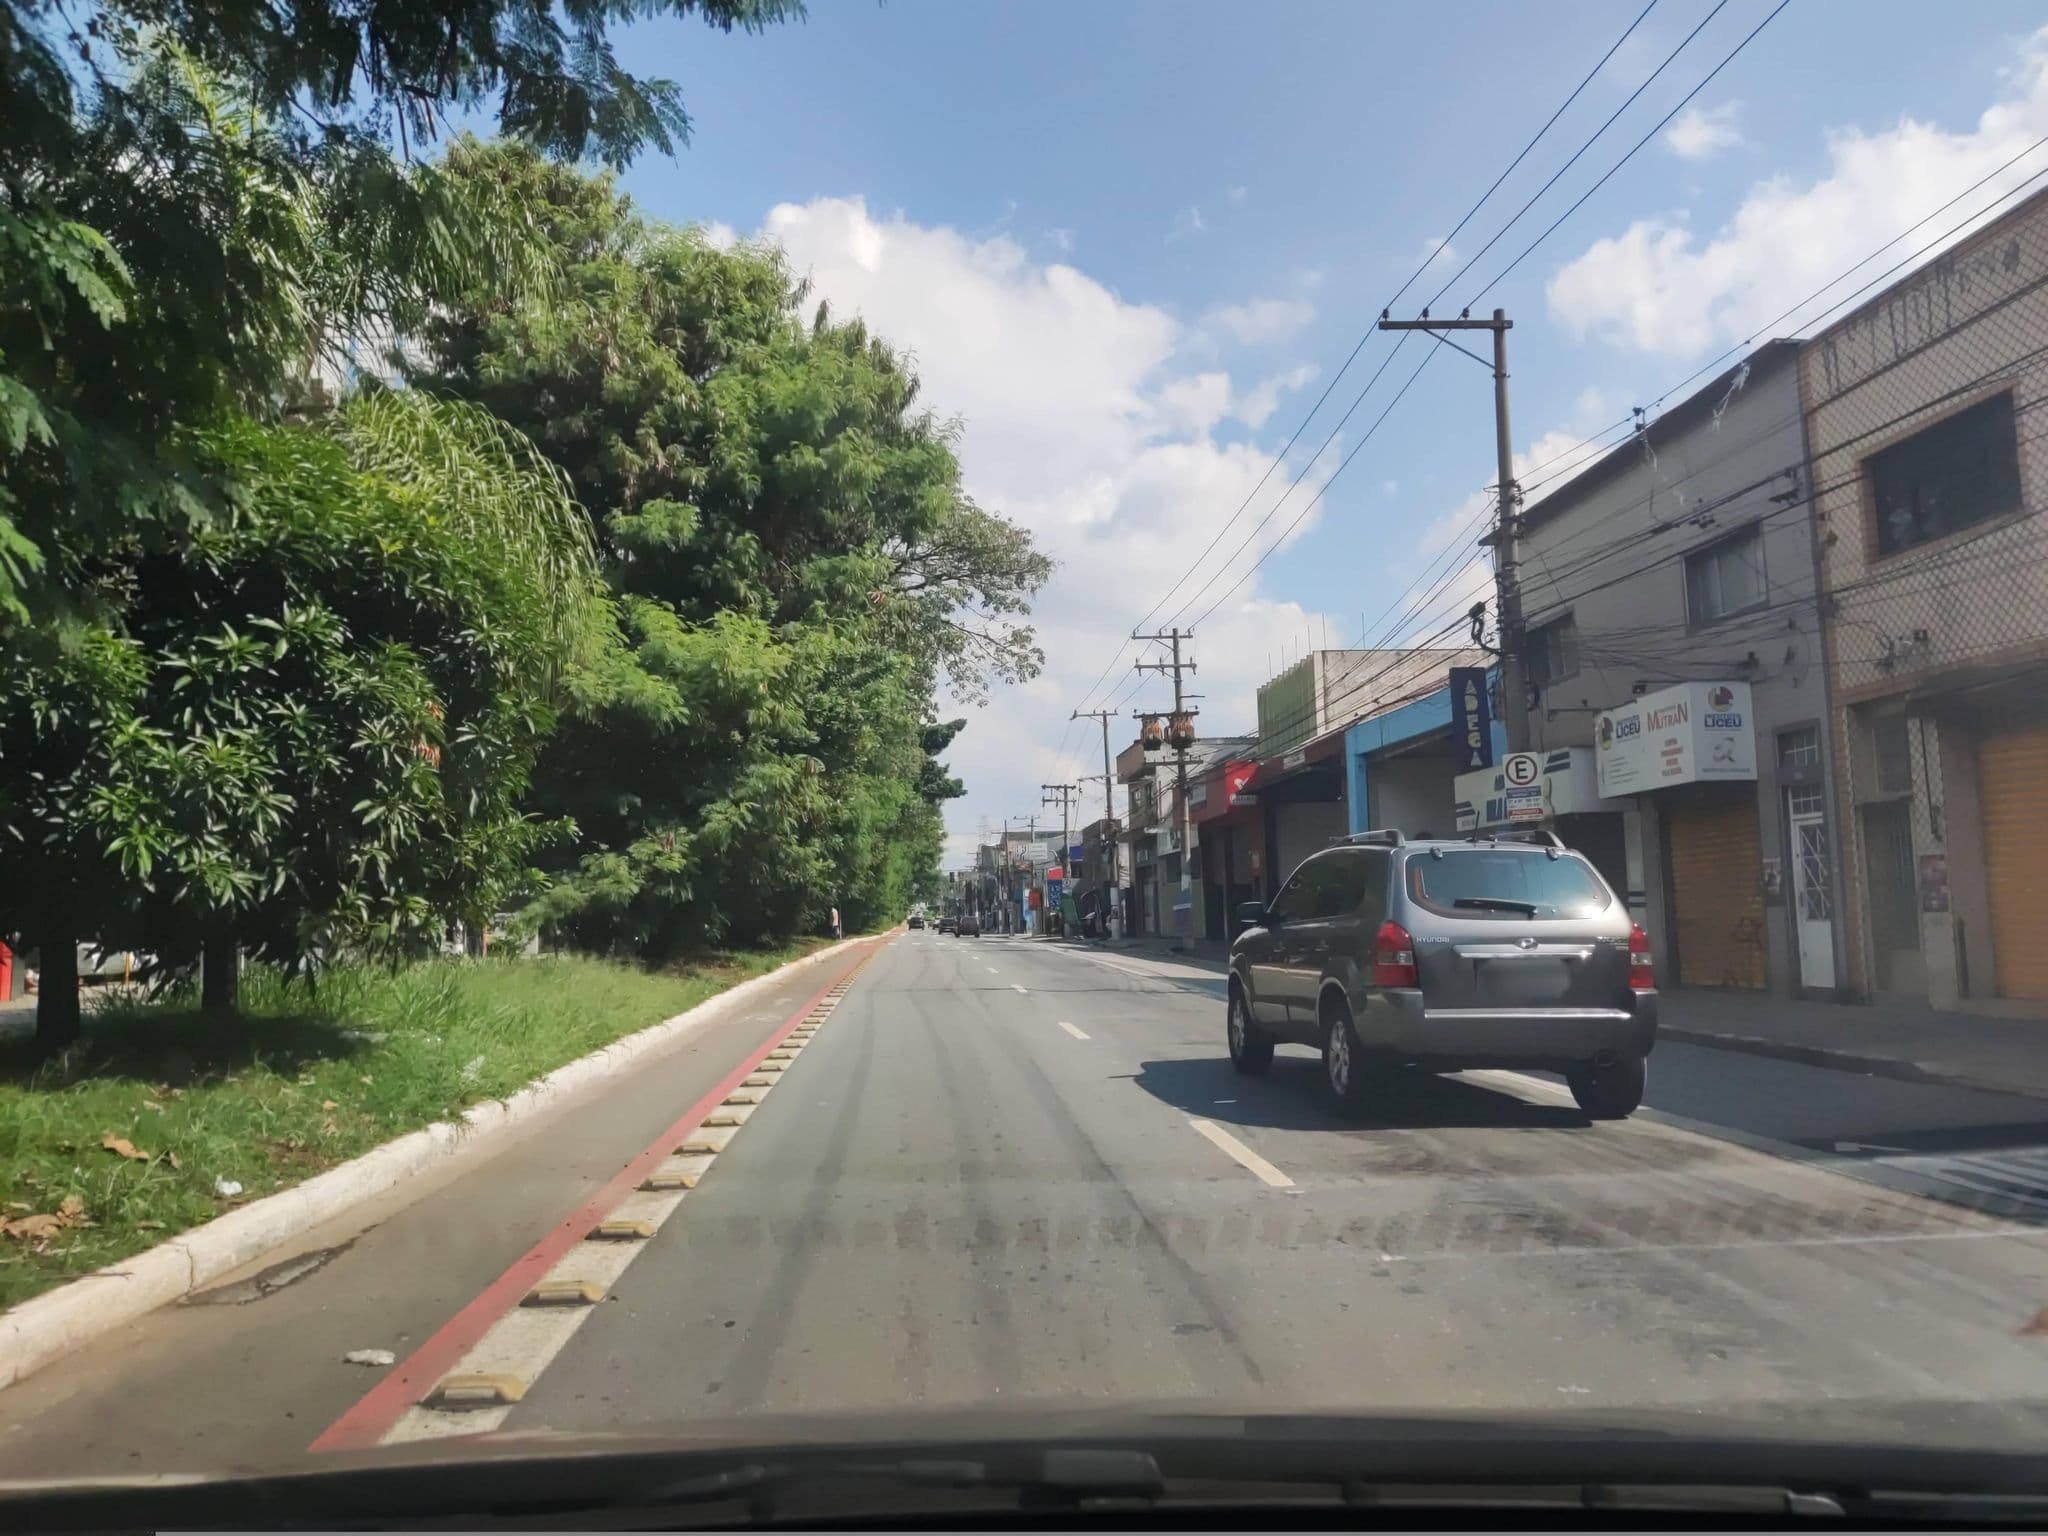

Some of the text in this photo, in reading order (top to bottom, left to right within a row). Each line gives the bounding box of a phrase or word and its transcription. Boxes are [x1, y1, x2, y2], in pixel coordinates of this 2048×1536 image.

[1464, 679, 1483, 767] ADEGA
[1616, 720, 1641, 739] LICEU
[1704, 717, 1742, 728] LICEU
[1515, 761, 1529, 780] E
[1416, 936, 1450, 944] HYUNDAI
